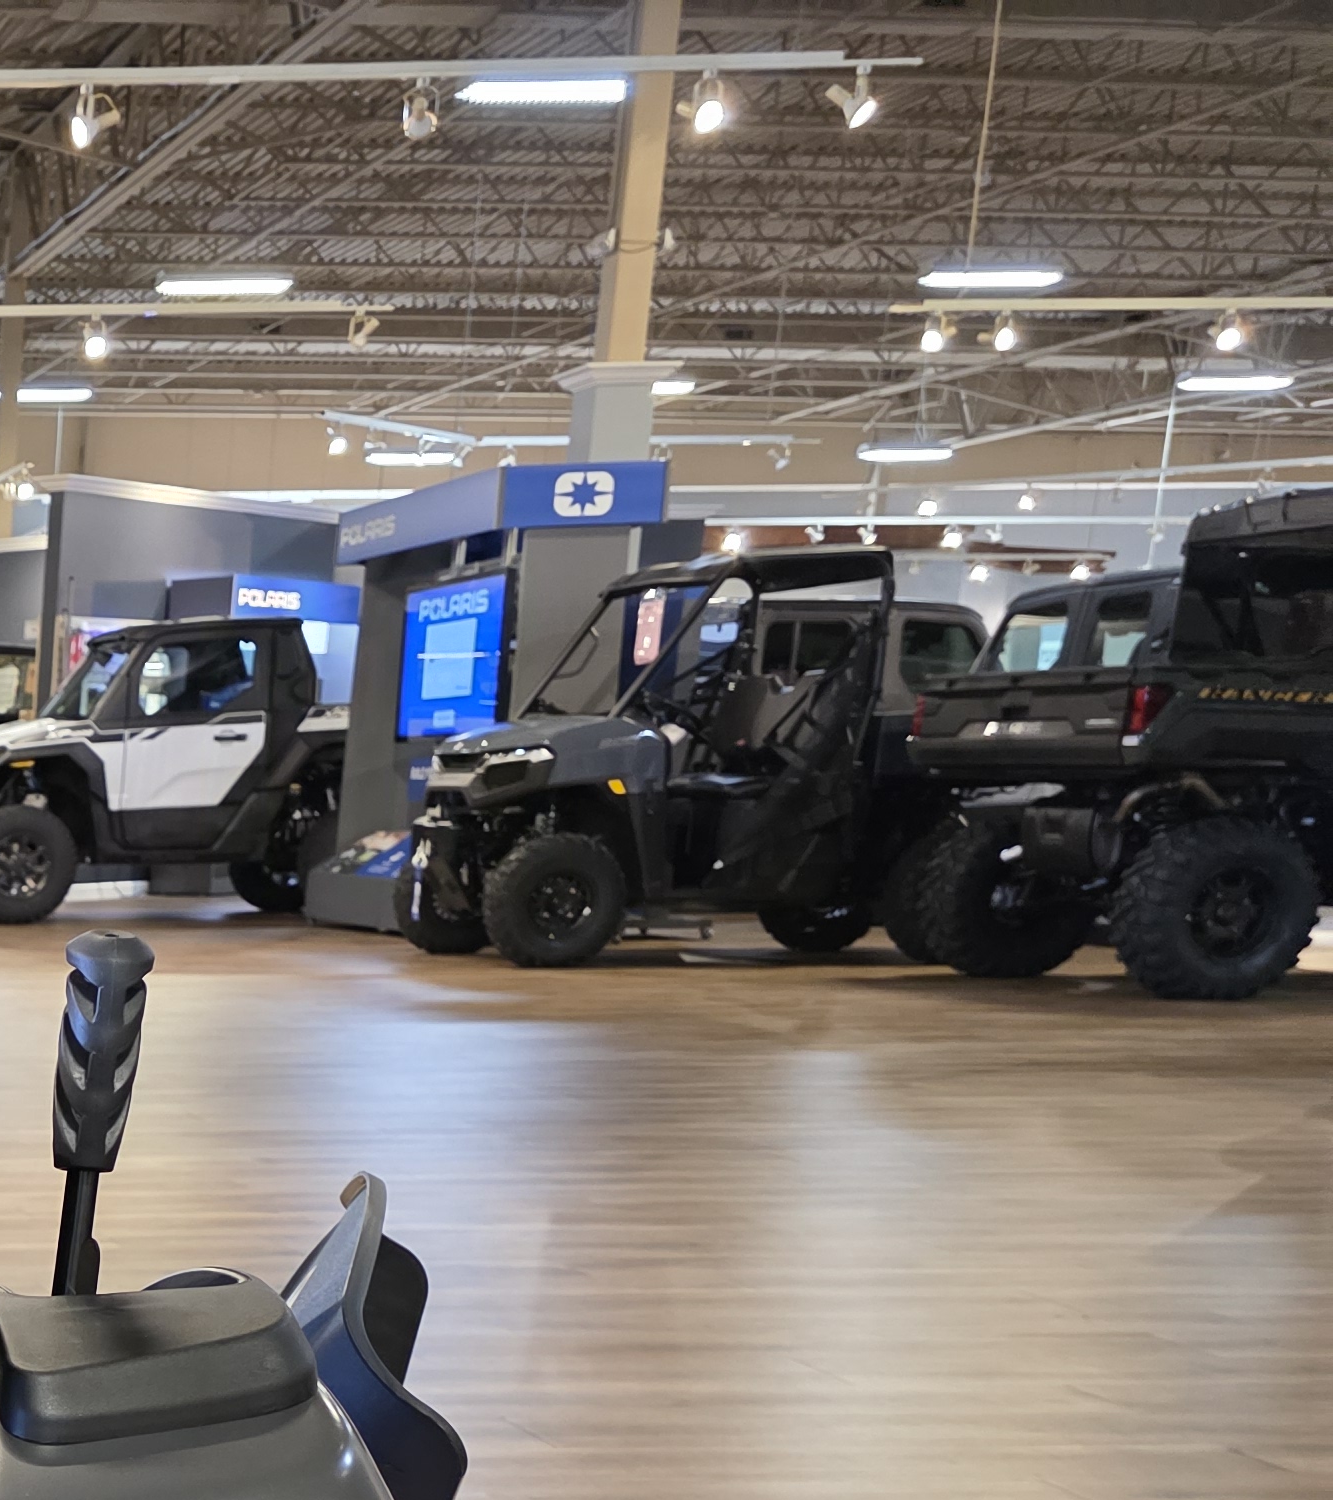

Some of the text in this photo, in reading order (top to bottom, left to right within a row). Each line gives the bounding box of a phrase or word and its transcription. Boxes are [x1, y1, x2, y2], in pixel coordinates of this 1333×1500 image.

[340, 514, 396, 548] POLARIS
[237, 587, 302, 610] POLARIS
[418, 588, 490, 622] POLARIS
